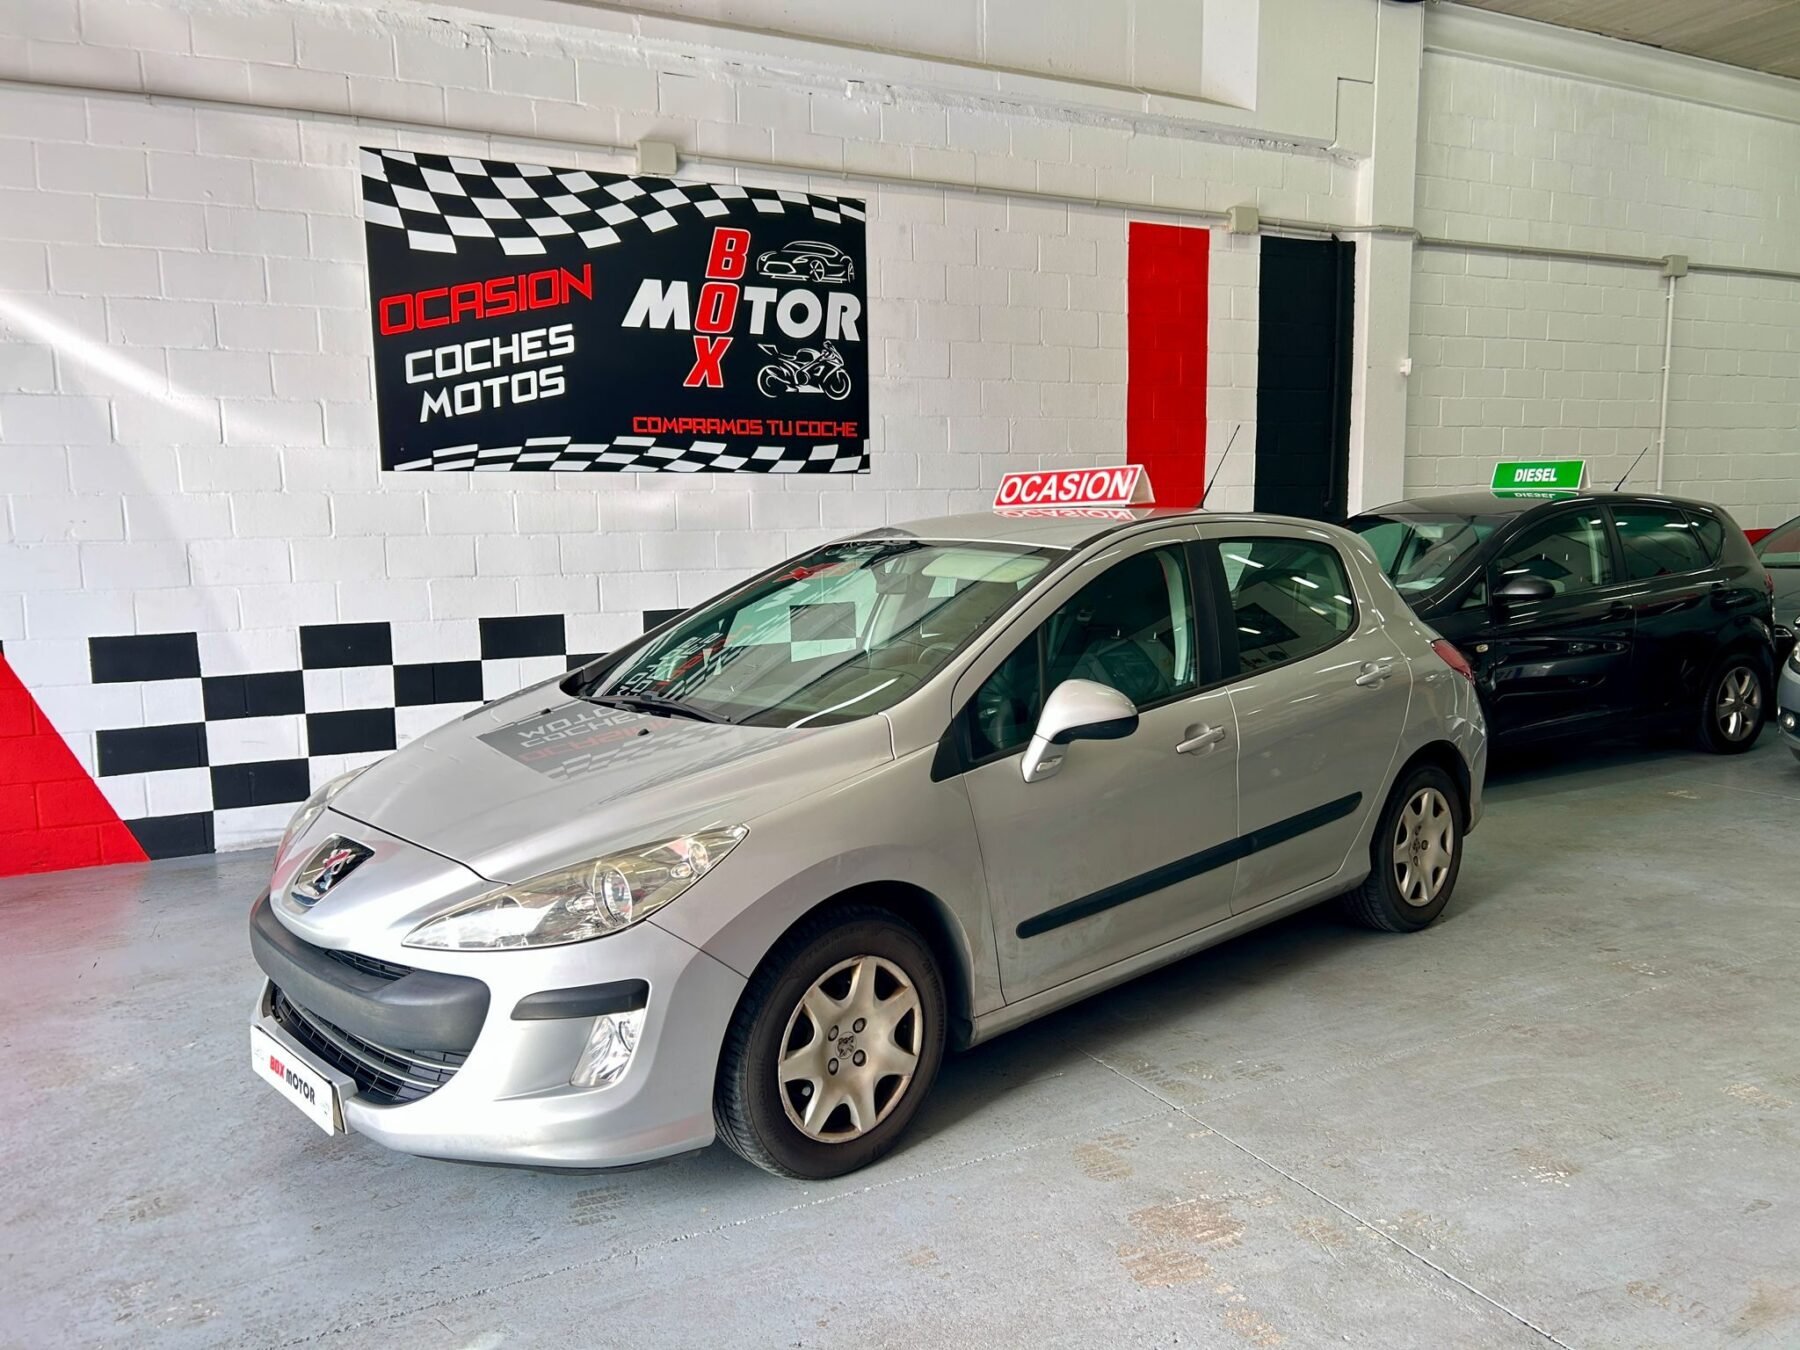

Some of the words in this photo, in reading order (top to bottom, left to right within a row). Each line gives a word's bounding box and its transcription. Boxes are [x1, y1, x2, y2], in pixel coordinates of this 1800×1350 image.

[379, 264, 593, 335] OCASION
[683, 227, 751, 388] BOX
[404, 324, 575, 384] COCHES
[419, 365, 565, 422] MOTOS
[632, 416, 763, 436] COMPRAMOS
[767, 420, 793, 436] TU
[796, 420, 858, 437] COCHE
[1000, 470, 1133, 503] OCASION
[1514, 468, 1557, 482] DIESEL
[270, 1055, 285, 1079] BOX
[286, 1068, 316, 1105] MOTOR
